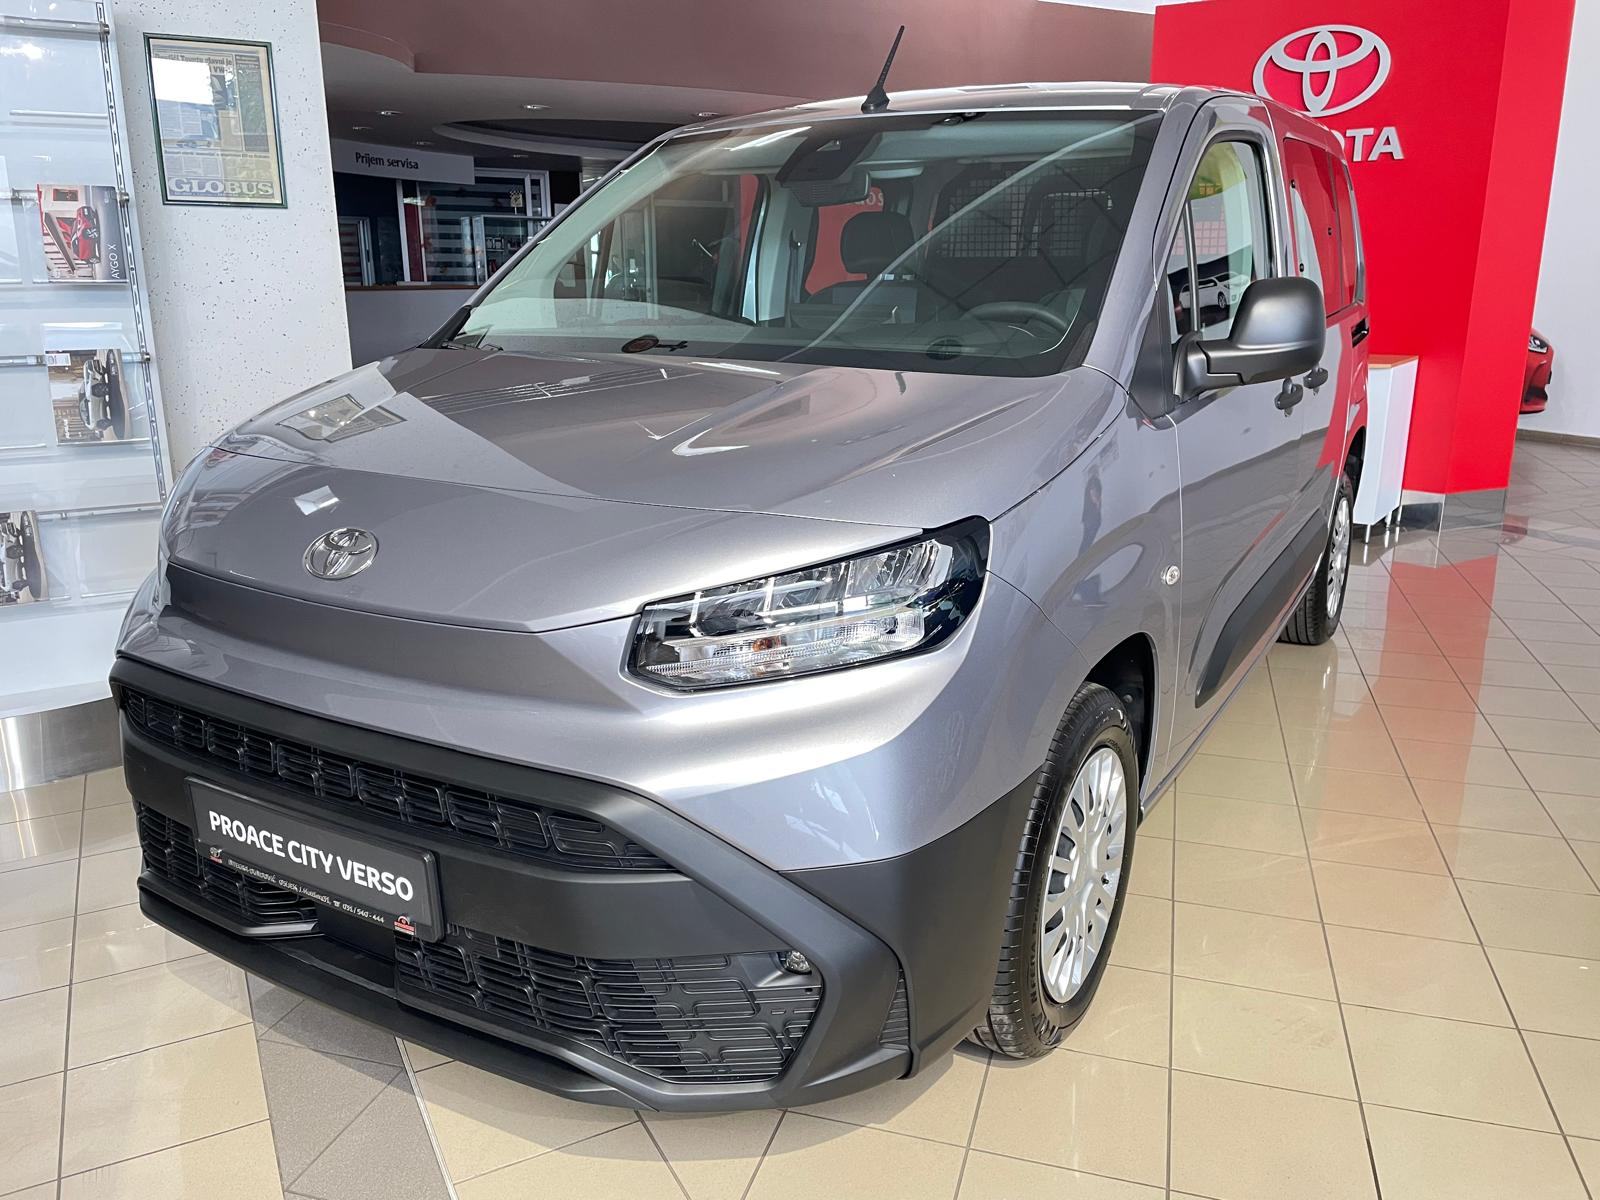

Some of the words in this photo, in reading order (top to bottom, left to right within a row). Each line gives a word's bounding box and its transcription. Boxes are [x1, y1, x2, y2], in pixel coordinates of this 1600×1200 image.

[355, 151, 384, 168] Prijem
[387, 158, 419, 170] servisa
[168, 177, 274, 195] GLOBUS
[108, 242, 117, 251] X
[109, 252, 120, 279] AYGO
[209, 810, 286, 858] PROACE
[287, 839, 334, 875] CITY
[336, 855, 414, 902] VERSO
